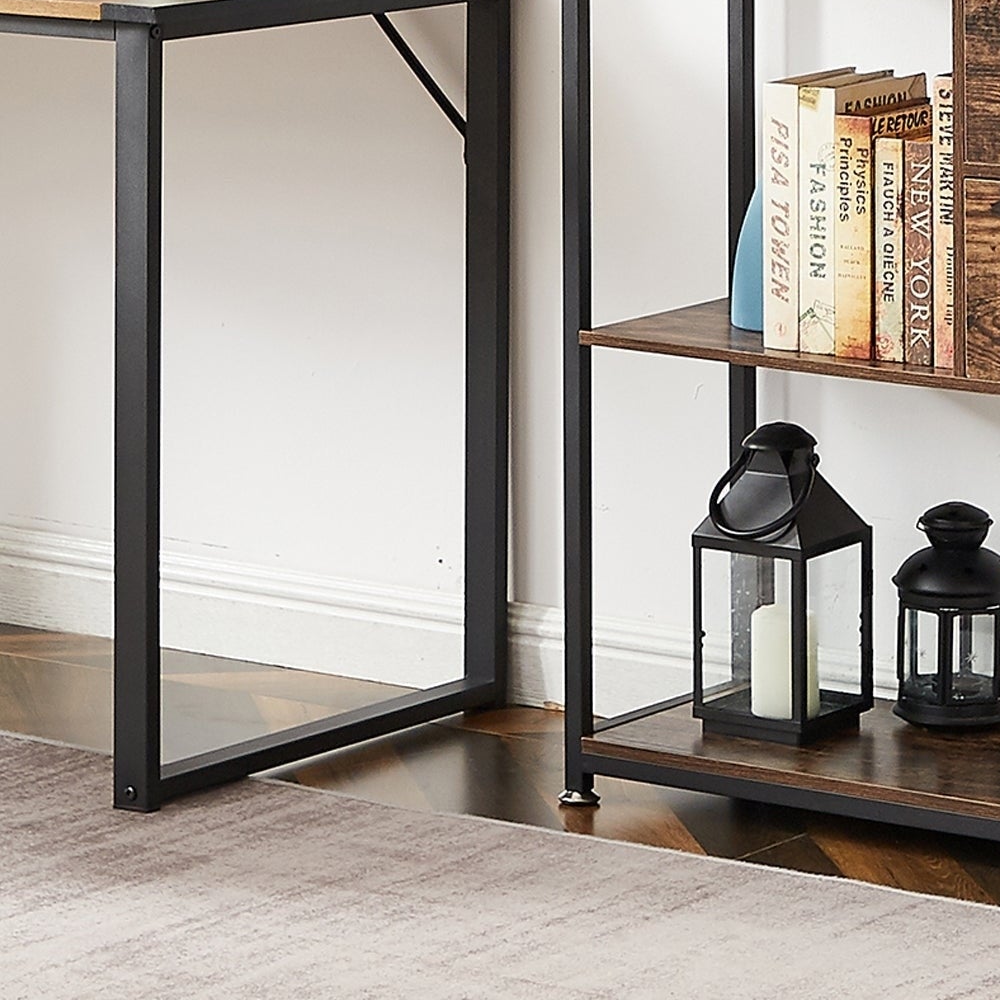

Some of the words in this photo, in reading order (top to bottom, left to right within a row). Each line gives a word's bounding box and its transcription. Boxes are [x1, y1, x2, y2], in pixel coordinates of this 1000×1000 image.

[770, 117, 790, 188] PISA
[887, 110, 929, 133] RETOUR
[836, 137, 853, 222] Principles
[854, 148, 869, 215] Physics
[883, 162, 894, 222] FIAUCH
[910, 161, 931, 239] NEW
[809, 163, 826, 279] FASHION
[883, 227, 894, 238] A
[910, 259, 932, 349] YORK
